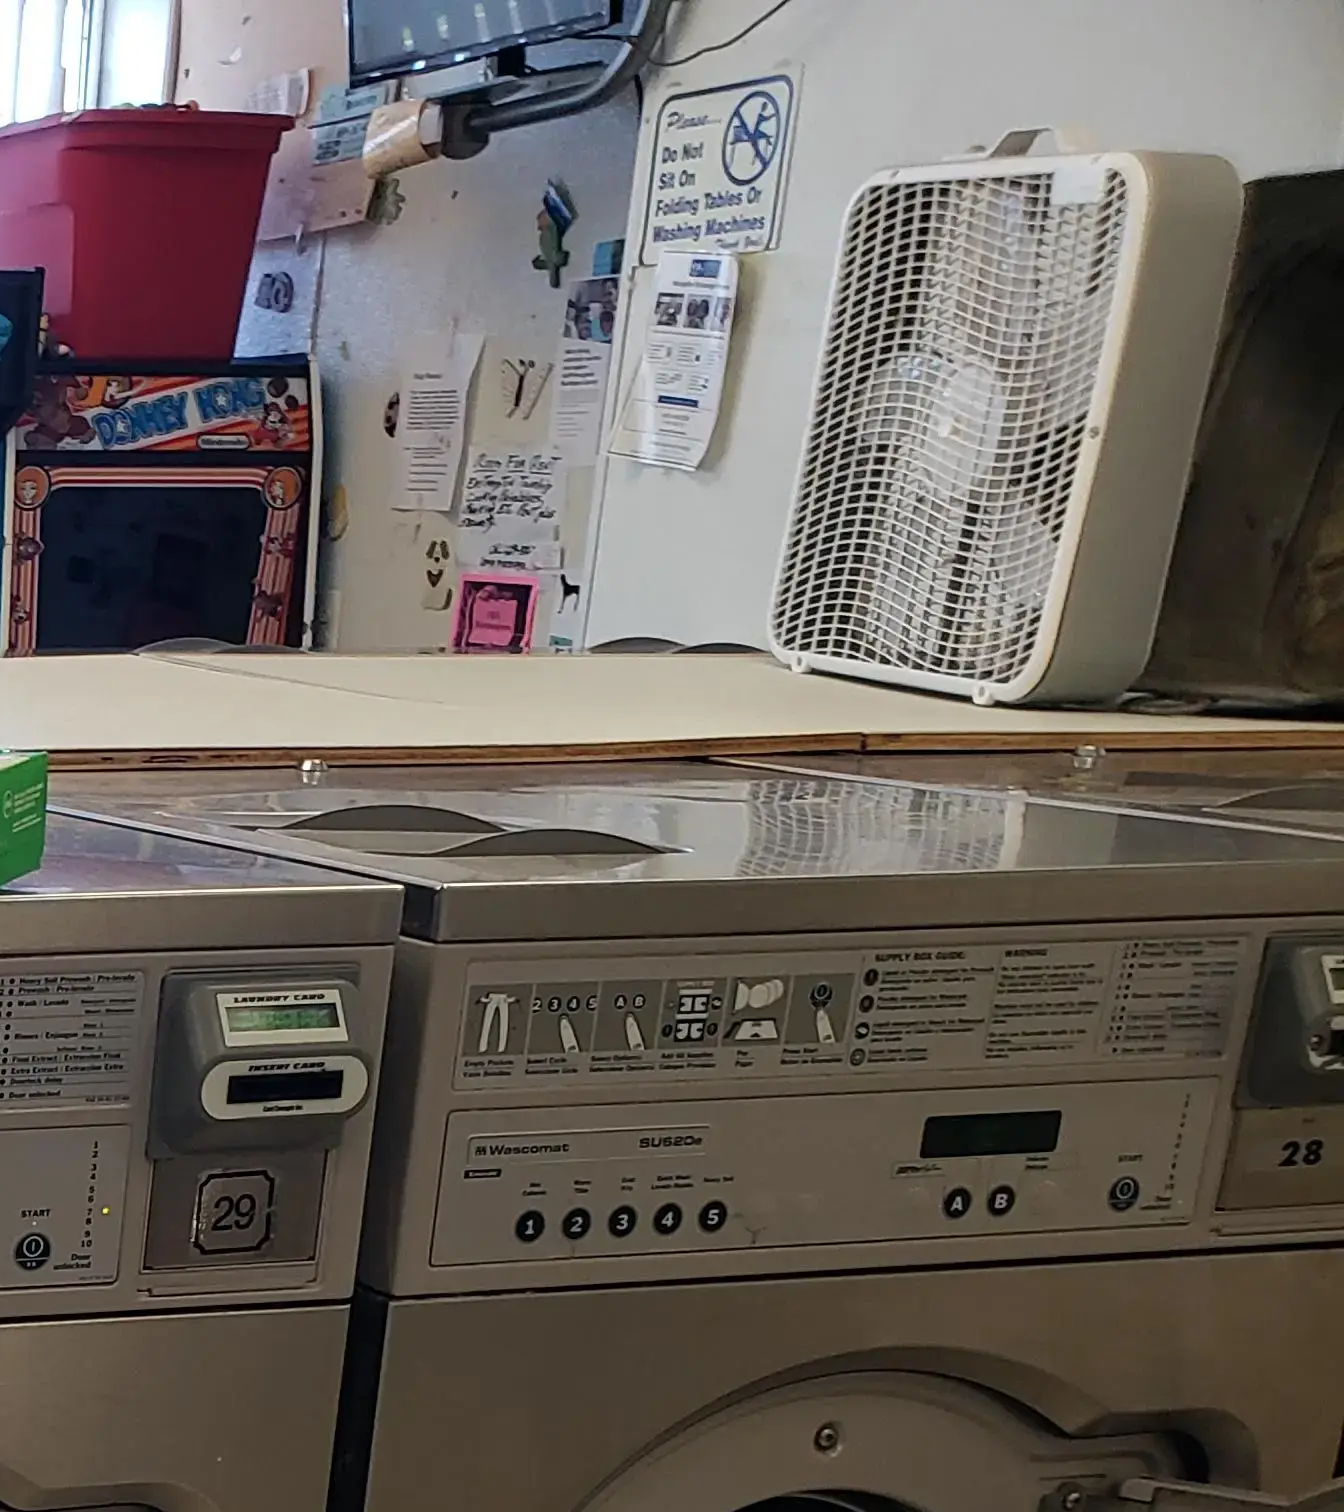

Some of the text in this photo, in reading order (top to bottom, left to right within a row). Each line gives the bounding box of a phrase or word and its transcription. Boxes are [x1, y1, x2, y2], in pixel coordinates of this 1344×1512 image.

[662, 142, 704, 164] Do Not
[658, 169, 696, 190] Sit On
[655, 186, 763, 217] Folding Tables Or
[653, 214, 766, 244] Washing Machines
[91, 377, 266, 449] DONKEY KONG
[875, 953, 911, 962] SUPPLY
[914, 952, 932, 961] BOX
[234, 993, 325, 1003] LAUNDRY CARD
[247, 1061, 325, 1072] INSERT CARD
[489, 1143, 570, 1156] Wascomat
[638, 1135, 703, 1149] SU620e
[1277, 1138, 1325, 1168] 28
[950, 1194, 1008, 1211] A B
[21, 1209, 51, 1218] START
[211, 1194, 257, 1231] 29
[524, 1209, 720, 1235] 1 2 3 4 5
[81, 1239, 93, 1248] 10
